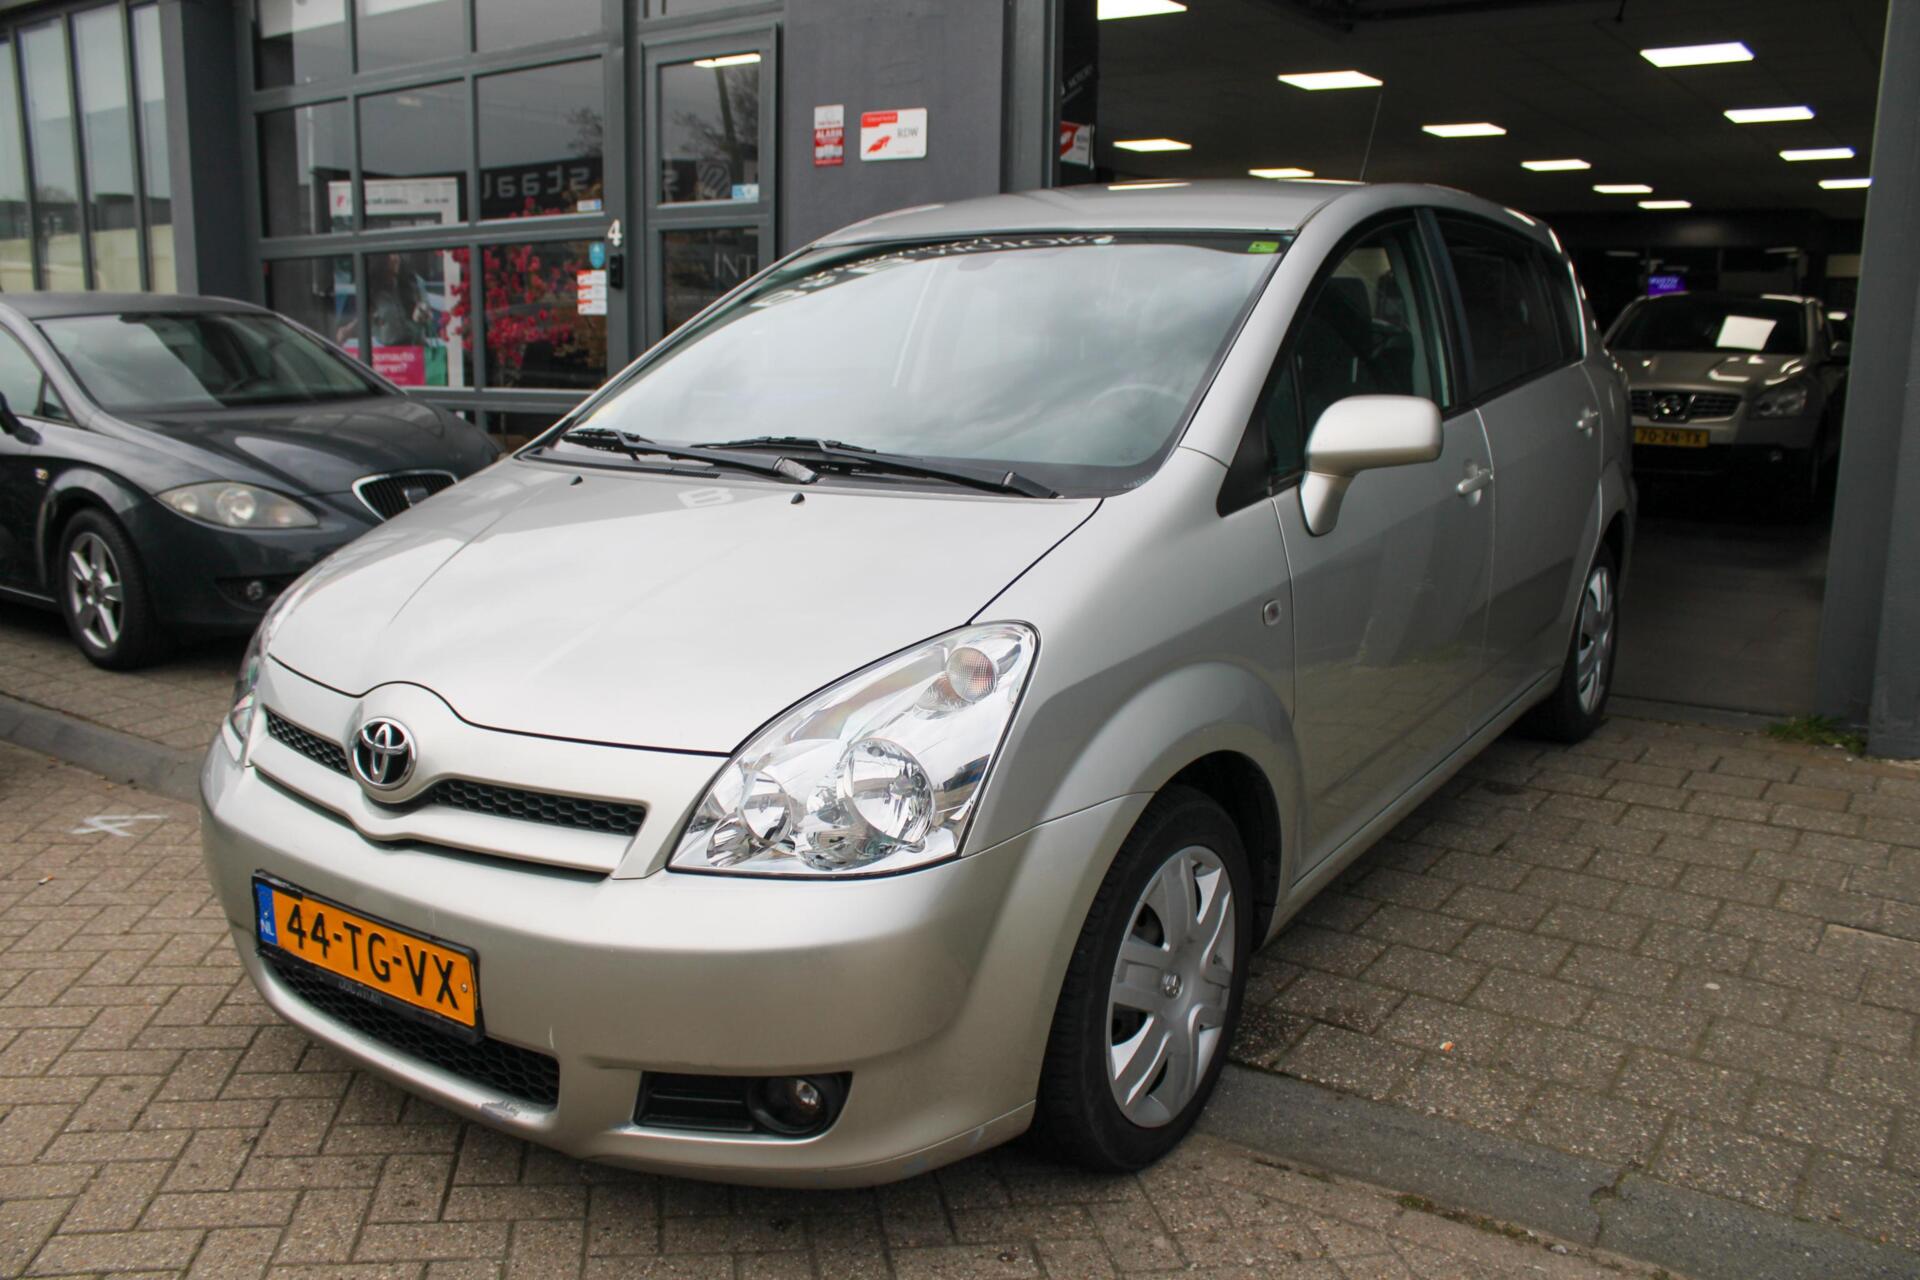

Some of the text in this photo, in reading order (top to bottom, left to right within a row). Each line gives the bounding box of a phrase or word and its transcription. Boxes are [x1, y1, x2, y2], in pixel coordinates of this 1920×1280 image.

[897, 127, 919, 138] RDW
[607, 219, 623, 247] 4
[1639, 429, 1702, 444] 70-ZN-TX
[260, 919, 275, 936] NL
[287, 904, 459, 1010] 44-TG-VX
